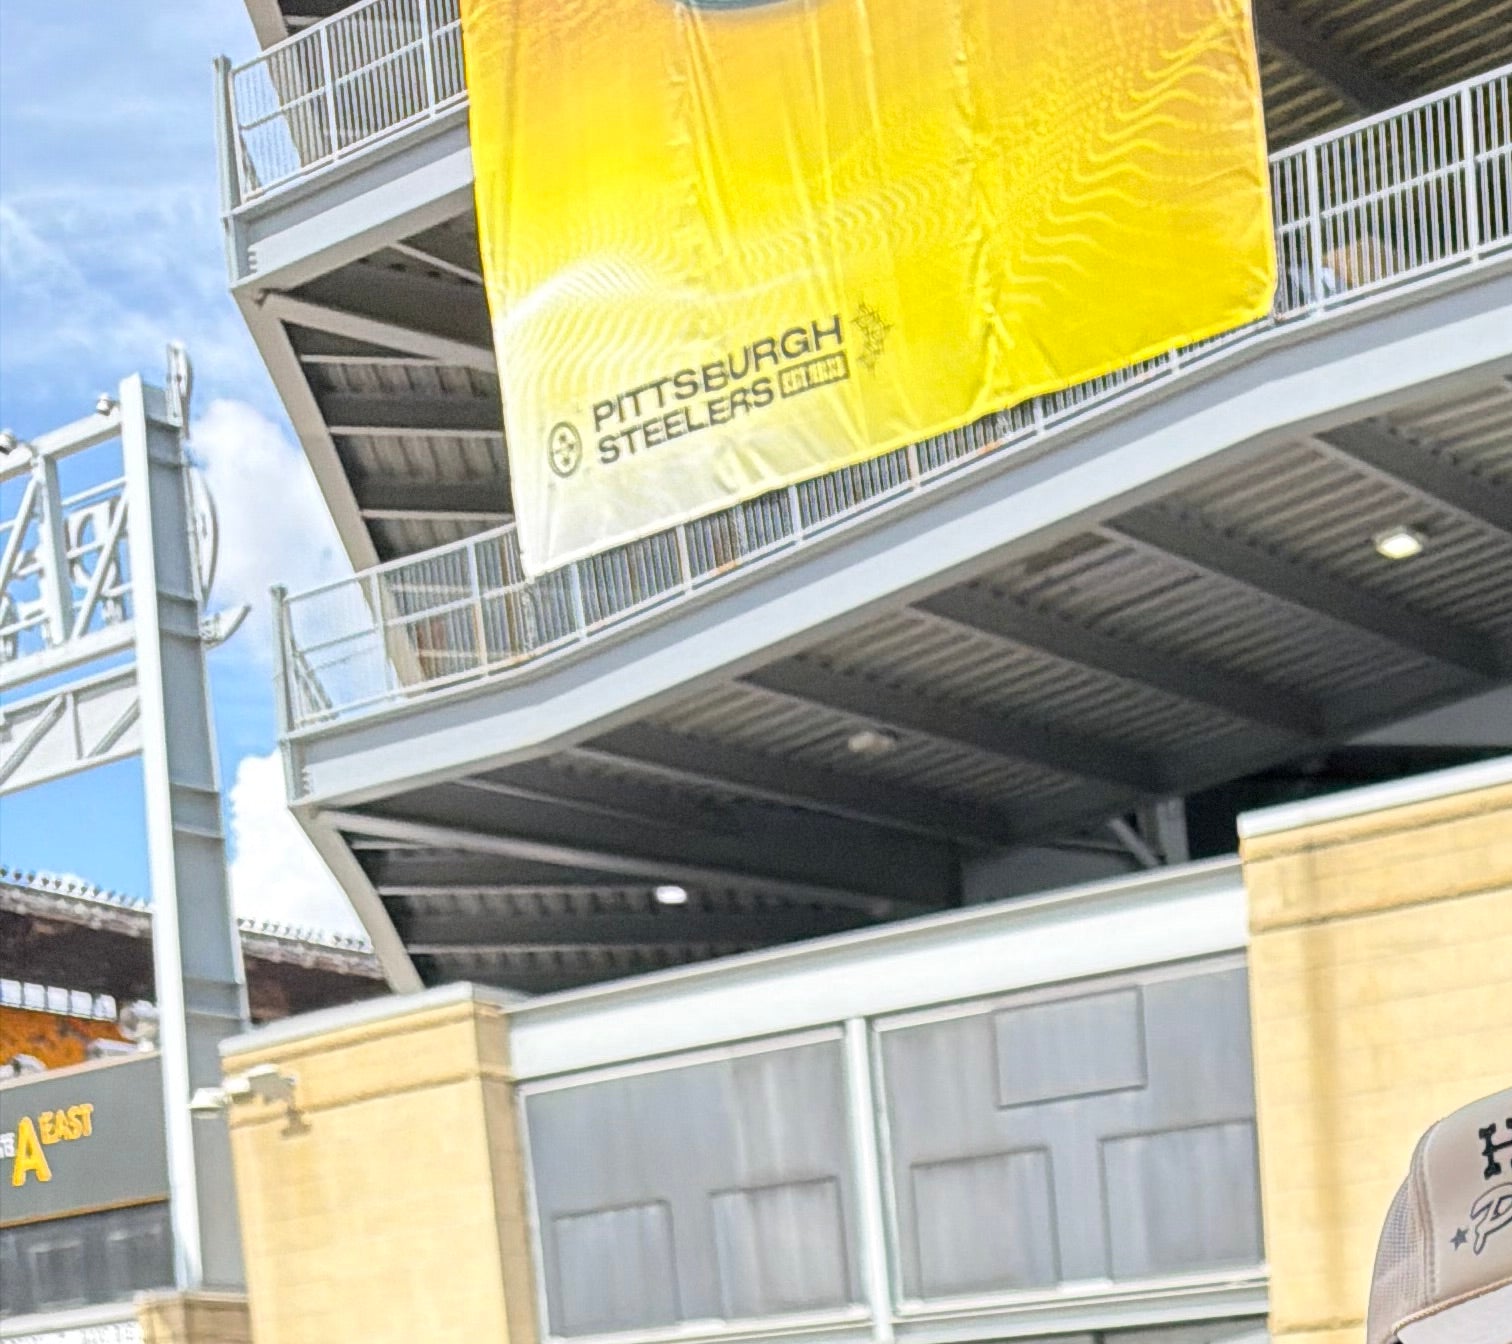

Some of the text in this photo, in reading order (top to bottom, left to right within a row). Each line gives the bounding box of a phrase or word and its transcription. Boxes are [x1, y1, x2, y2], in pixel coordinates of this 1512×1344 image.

[592, 314, 845, 432] PITTSBURGH
[598, 377, 775, 465] STEELERS
[12, 1116, 52, 1187] A
[38, 1103, 94, 1144] EAST
